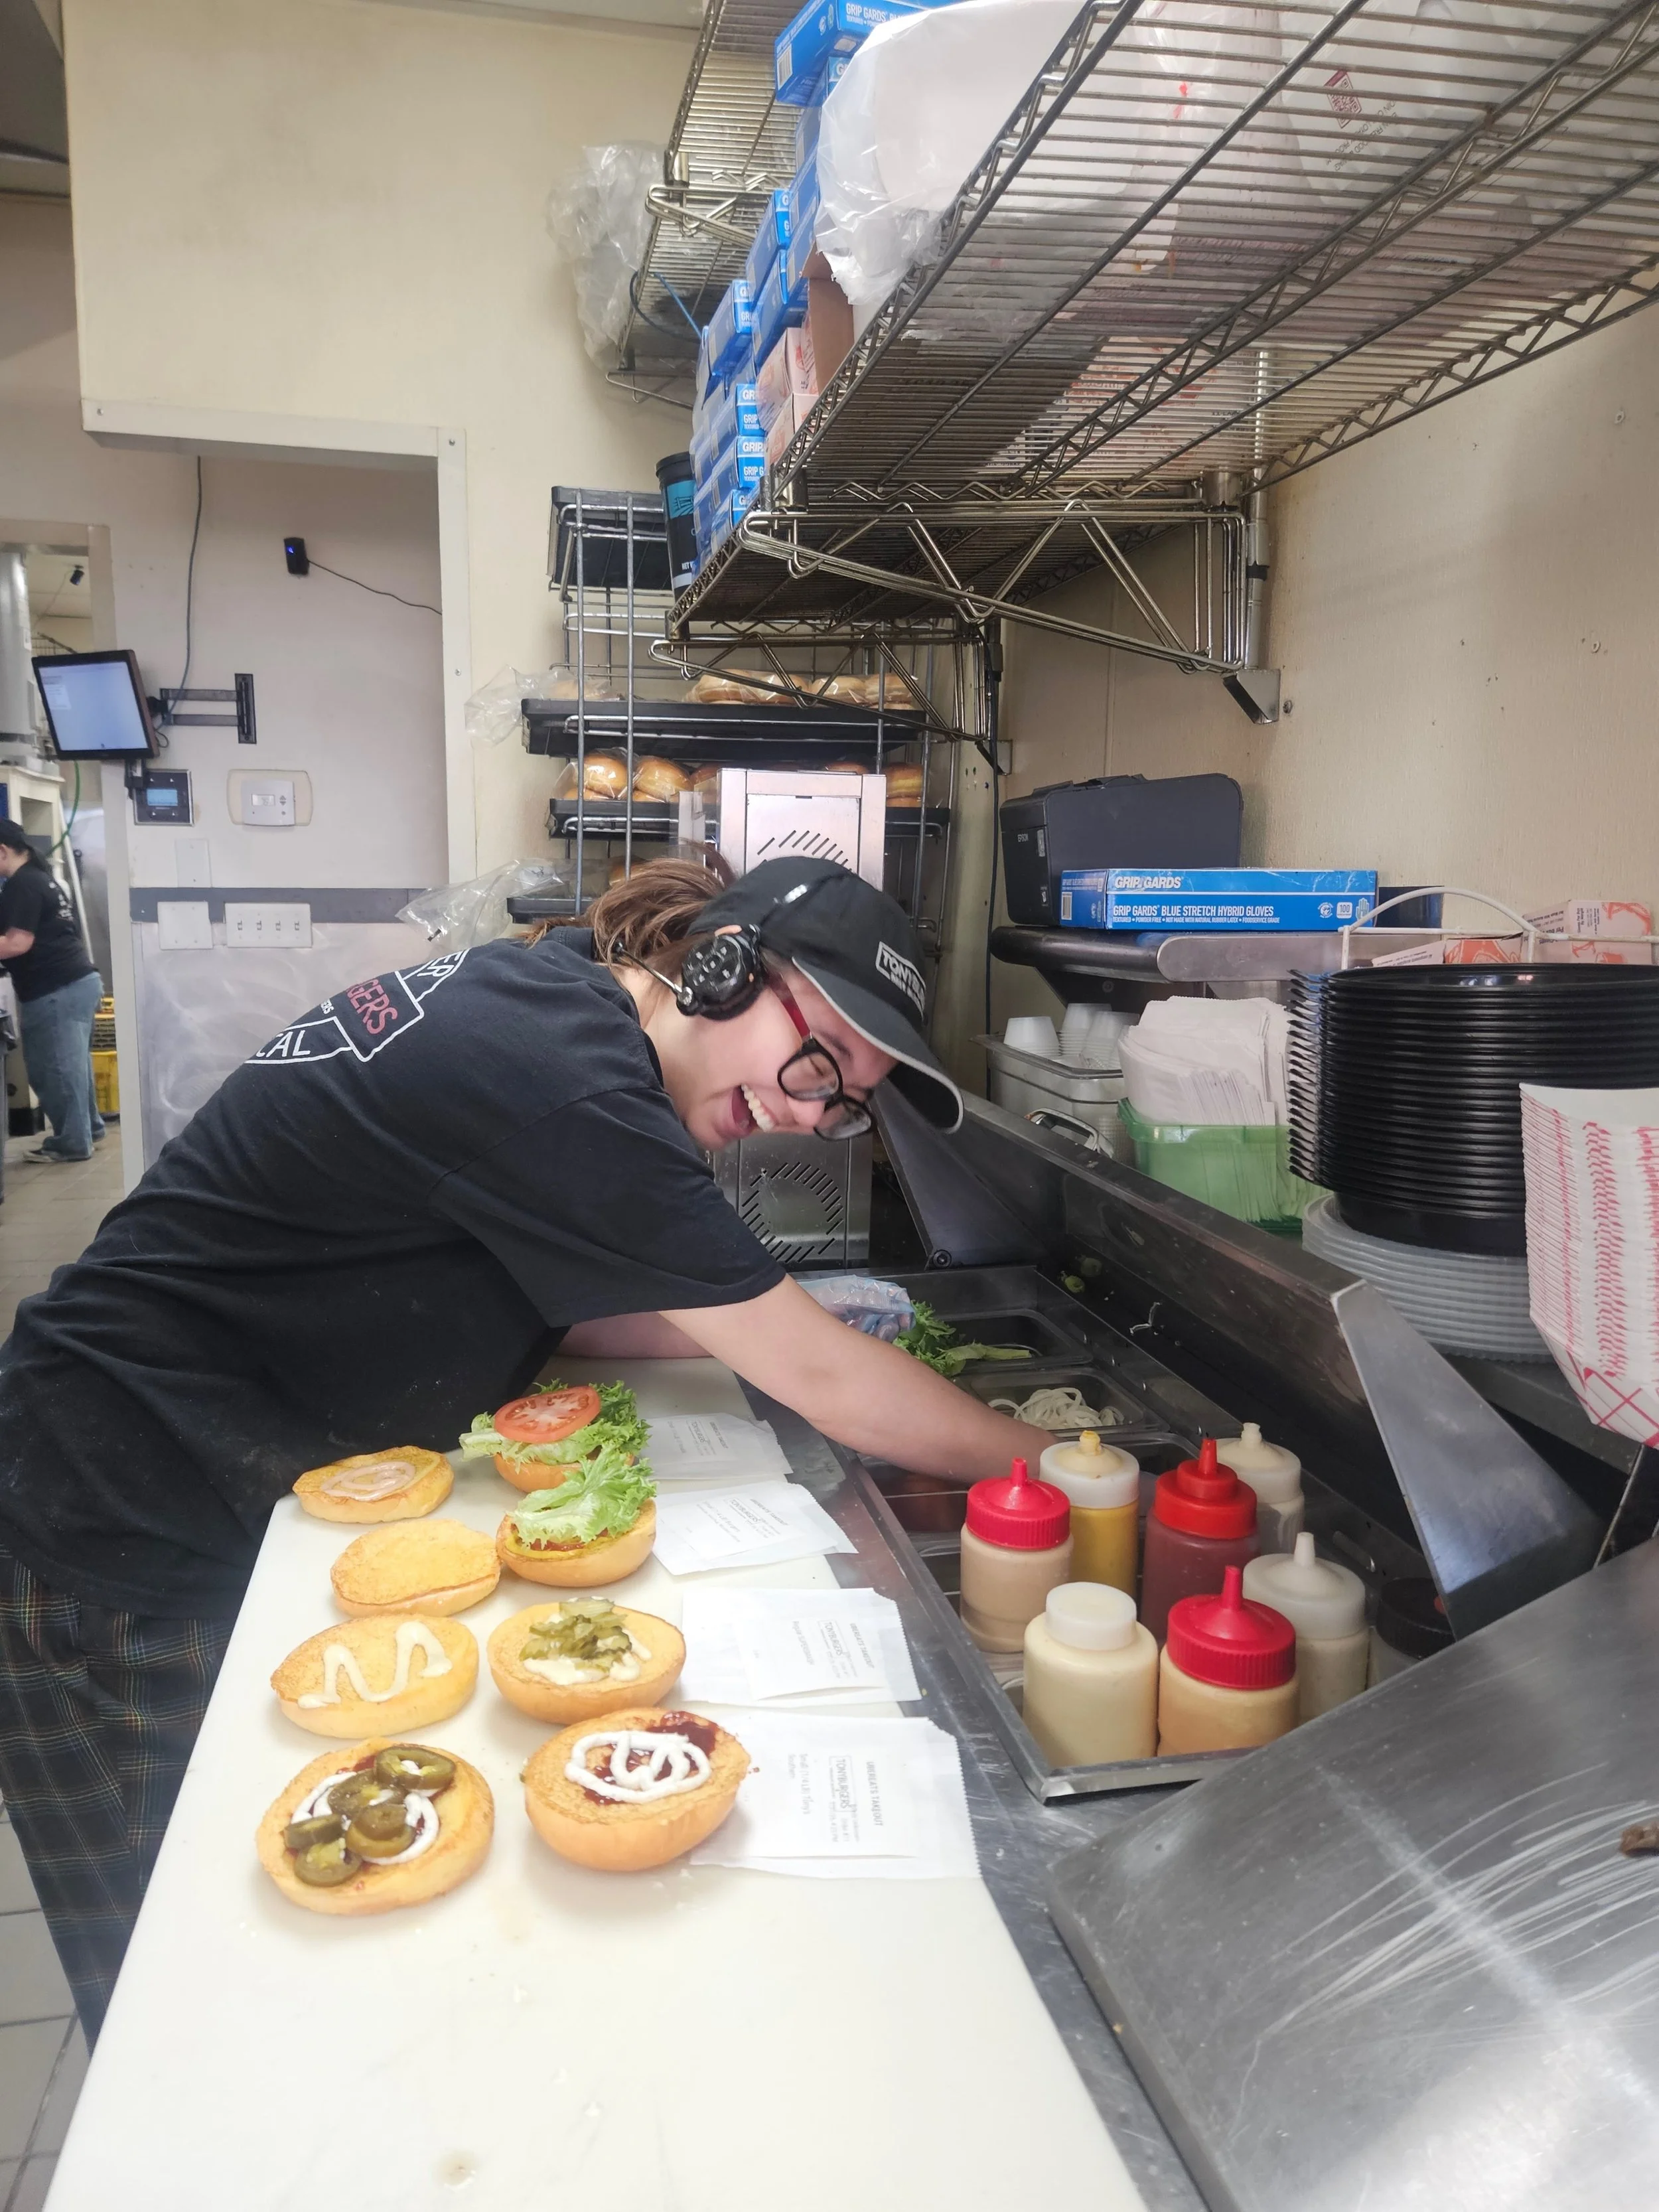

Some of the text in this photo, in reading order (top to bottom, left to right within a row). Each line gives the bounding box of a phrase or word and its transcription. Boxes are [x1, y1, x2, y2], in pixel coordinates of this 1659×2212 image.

[846, 3, 862, 16] GRIP
[744, 414, 758, 424] GRIP
[744, 467, 758, 476] GRIP
[1144, 876, 1181, 889] GARDS
[1114, 905, 1131, 917] GRIP
[1161, 905, 1182, 917] BLUE
[1183, 905, 1216, 917] STRETCH
[1218, 905, 1244, 917] HYBRID
[1246, 905, 1274, 917] GLOVES
[1339, 904, 1350, 913] 100
[835, 1759, 851, 1809] TONYBURGERS
[866, 1761, 883, 1826] UBEREATS TAKEOUT
